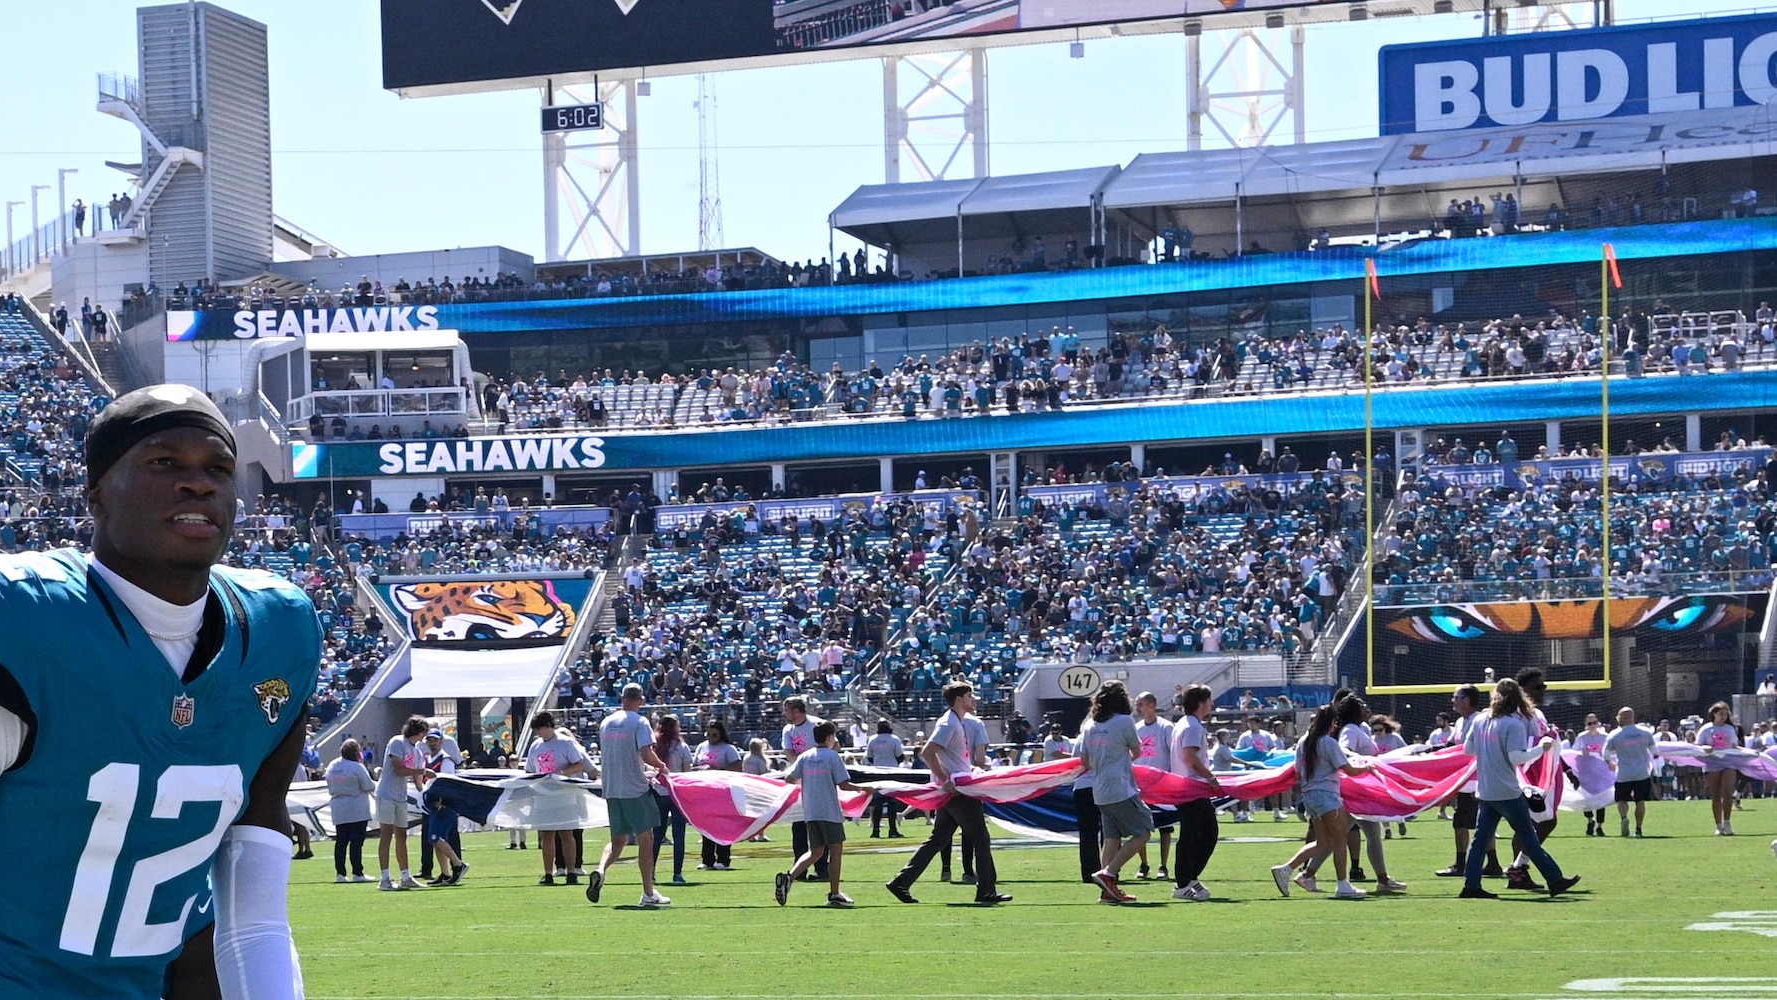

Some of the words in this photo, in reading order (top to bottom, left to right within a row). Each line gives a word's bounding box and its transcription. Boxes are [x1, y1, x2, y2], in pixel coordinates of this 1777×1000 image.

[1414, 48, 1630, 132] BUD
[557, 106, 598, 127] 6:02
[233, 305, 439, 338] SEAHAWKS
[379, 437, 606, 474] SEAHAWKS
[1066, 673, 1092, 690] 147
[174, 709, 191, 725] NFL
[59, 762, 244, 958] 12
